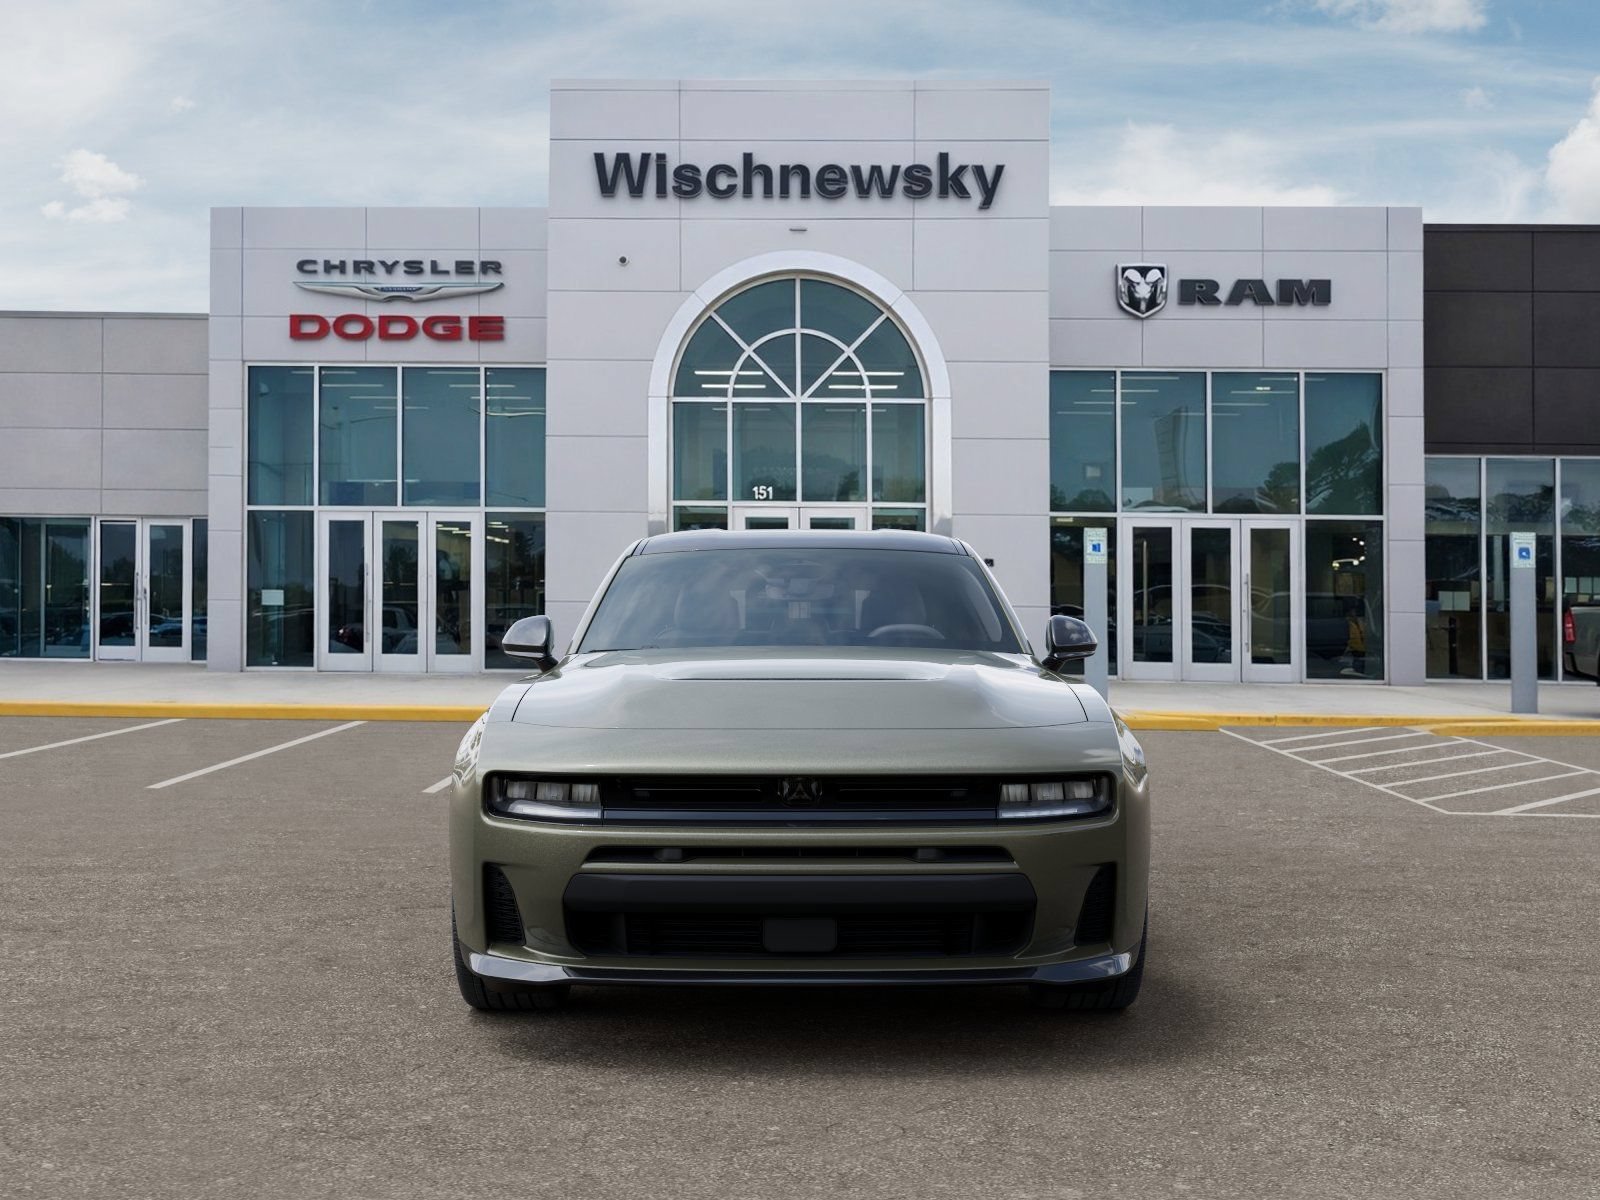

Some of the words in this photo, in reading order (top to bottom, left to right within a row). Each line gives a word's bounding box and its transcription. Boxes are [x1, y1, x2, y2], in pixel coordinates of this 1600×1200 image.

[593, 152, 1005, 210] Wischnewsky
[296, 259, 503, 275] CHRYSLER
[1177, 278, 1332, 306] RAM
[289, 313, 505, 341] DODGE
[752, 485, 773, 500] 151
